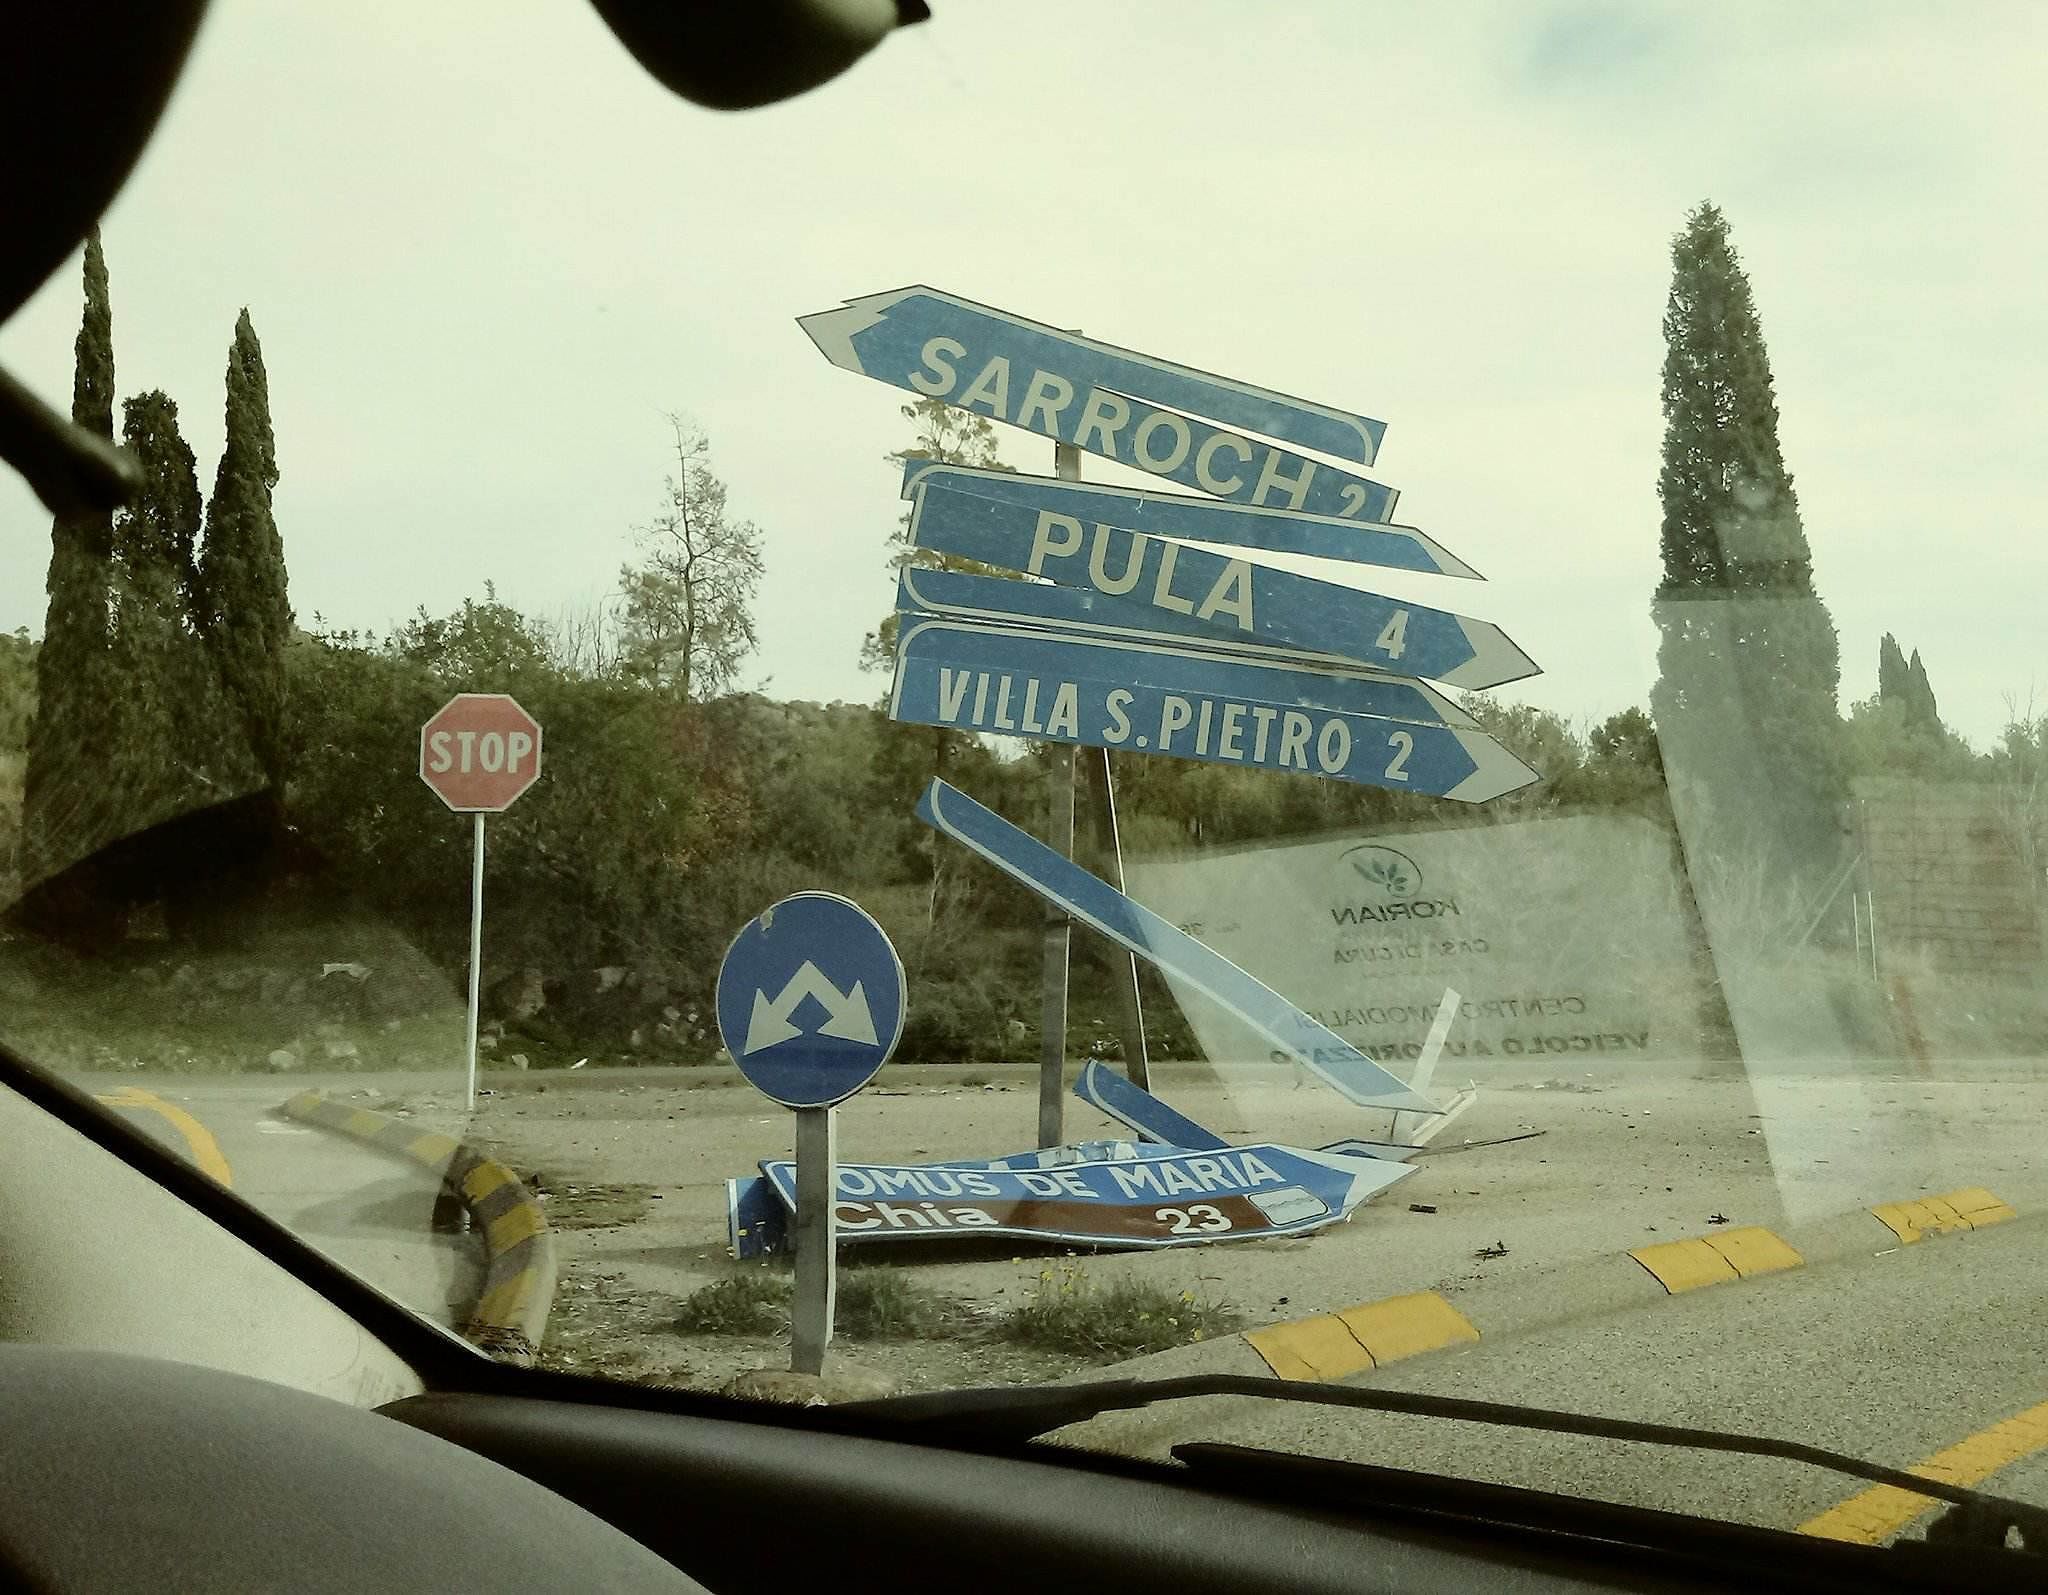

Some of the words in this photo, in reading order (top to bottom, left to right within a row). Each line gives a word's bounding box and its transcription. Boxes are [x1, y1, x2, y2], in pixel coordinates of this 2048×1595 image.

[908, 337, 1317, 509] SARROCH
[1027, 510, 1255, 632] PULA
[1376, 609, 1410, 660] 4
[429, 731, 532, 773] STOP
[938, 668, 1079, 738] VILLA
[1384, 731, 1414, 781] 2
[1014, 1171, 1099, 1198] DE
[1106, 1152, 1286, 1199] MARIA
[835, 1201, 999, 1229] Chia
[1155, 1204, 1233, 1234] 23
